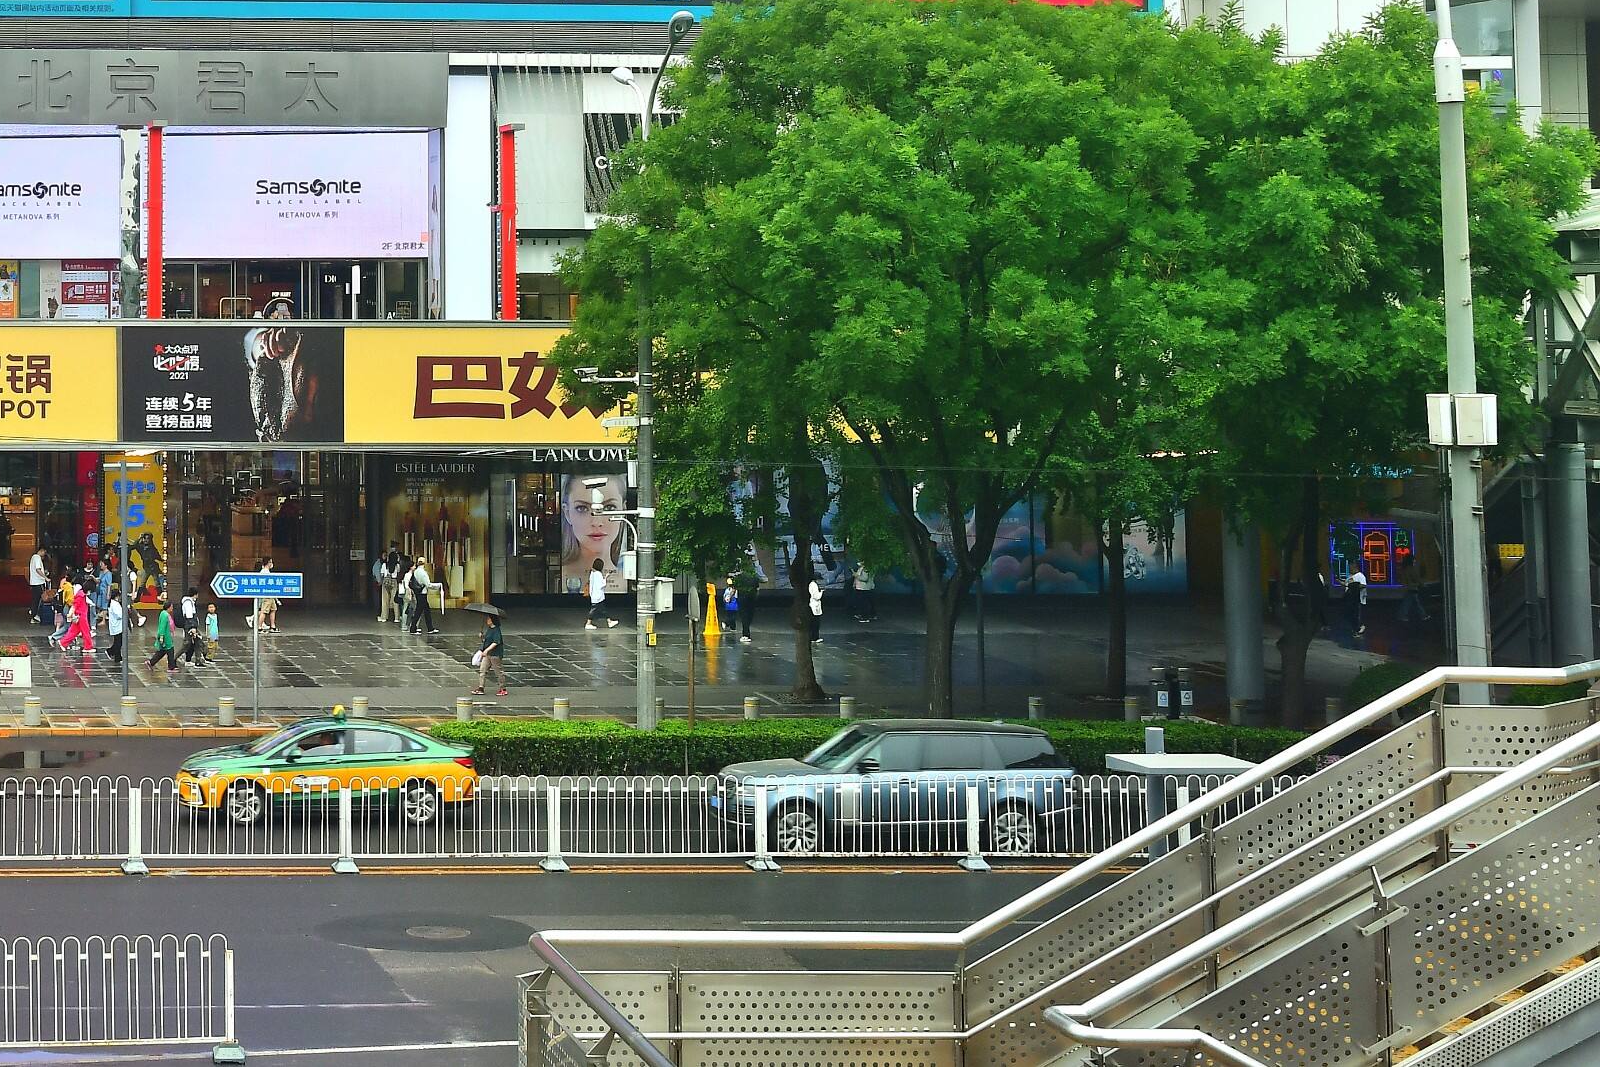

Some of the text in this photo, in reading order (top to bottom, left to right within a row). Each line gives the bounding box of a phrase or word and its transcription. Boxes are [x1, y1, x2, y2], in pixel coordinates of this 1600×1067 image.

[17, 57, 340, 116] 北京君太
[255, 179, 362, 197] Samsonite
[278, 210, 339, 219] METANOVA 系列
[381, 242, 425, 251] 2F 北京君太
[164, 344, 199, 354] 大众点评
[169, 372, 189, 380] 2021
[145, 393, 212, 412] 连续5年
[145, 414, 212, 429] 登榜品牌
[431, 462, 476, 474] LAUDER
[241, 577, 284, 586] 地铁西单站
